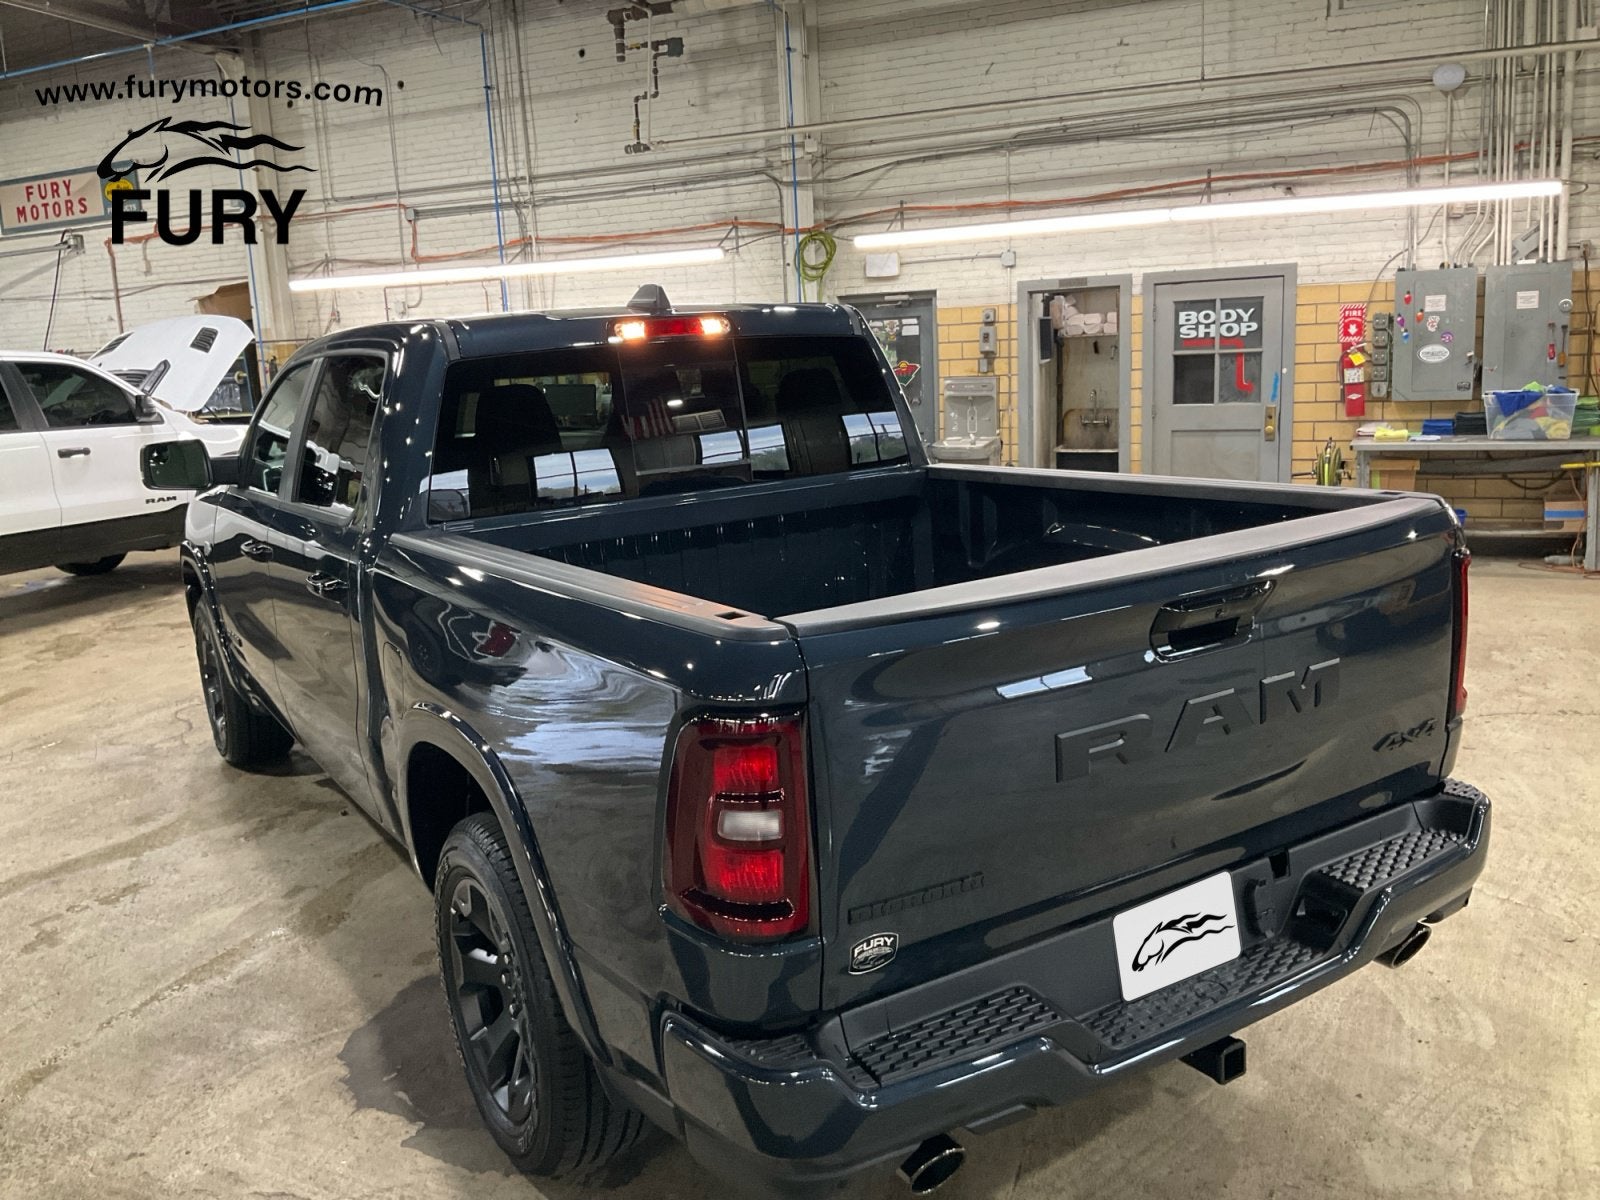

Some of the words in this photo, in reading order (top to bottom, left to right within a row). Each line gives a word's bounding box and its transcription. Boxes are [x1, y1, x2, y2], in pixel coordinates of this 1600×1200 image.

[25, 179, 71, 202] FURY
[16, 197, 88, 223] MOTORS
[1179, 308, 1255, 325] BODY
[1179, 322, 1258, 338] SHOP
[145, 495, 177, 504] RAM
[1054, 657, 1340, 784] RAM
[853, 936, 895, 958] FURY
